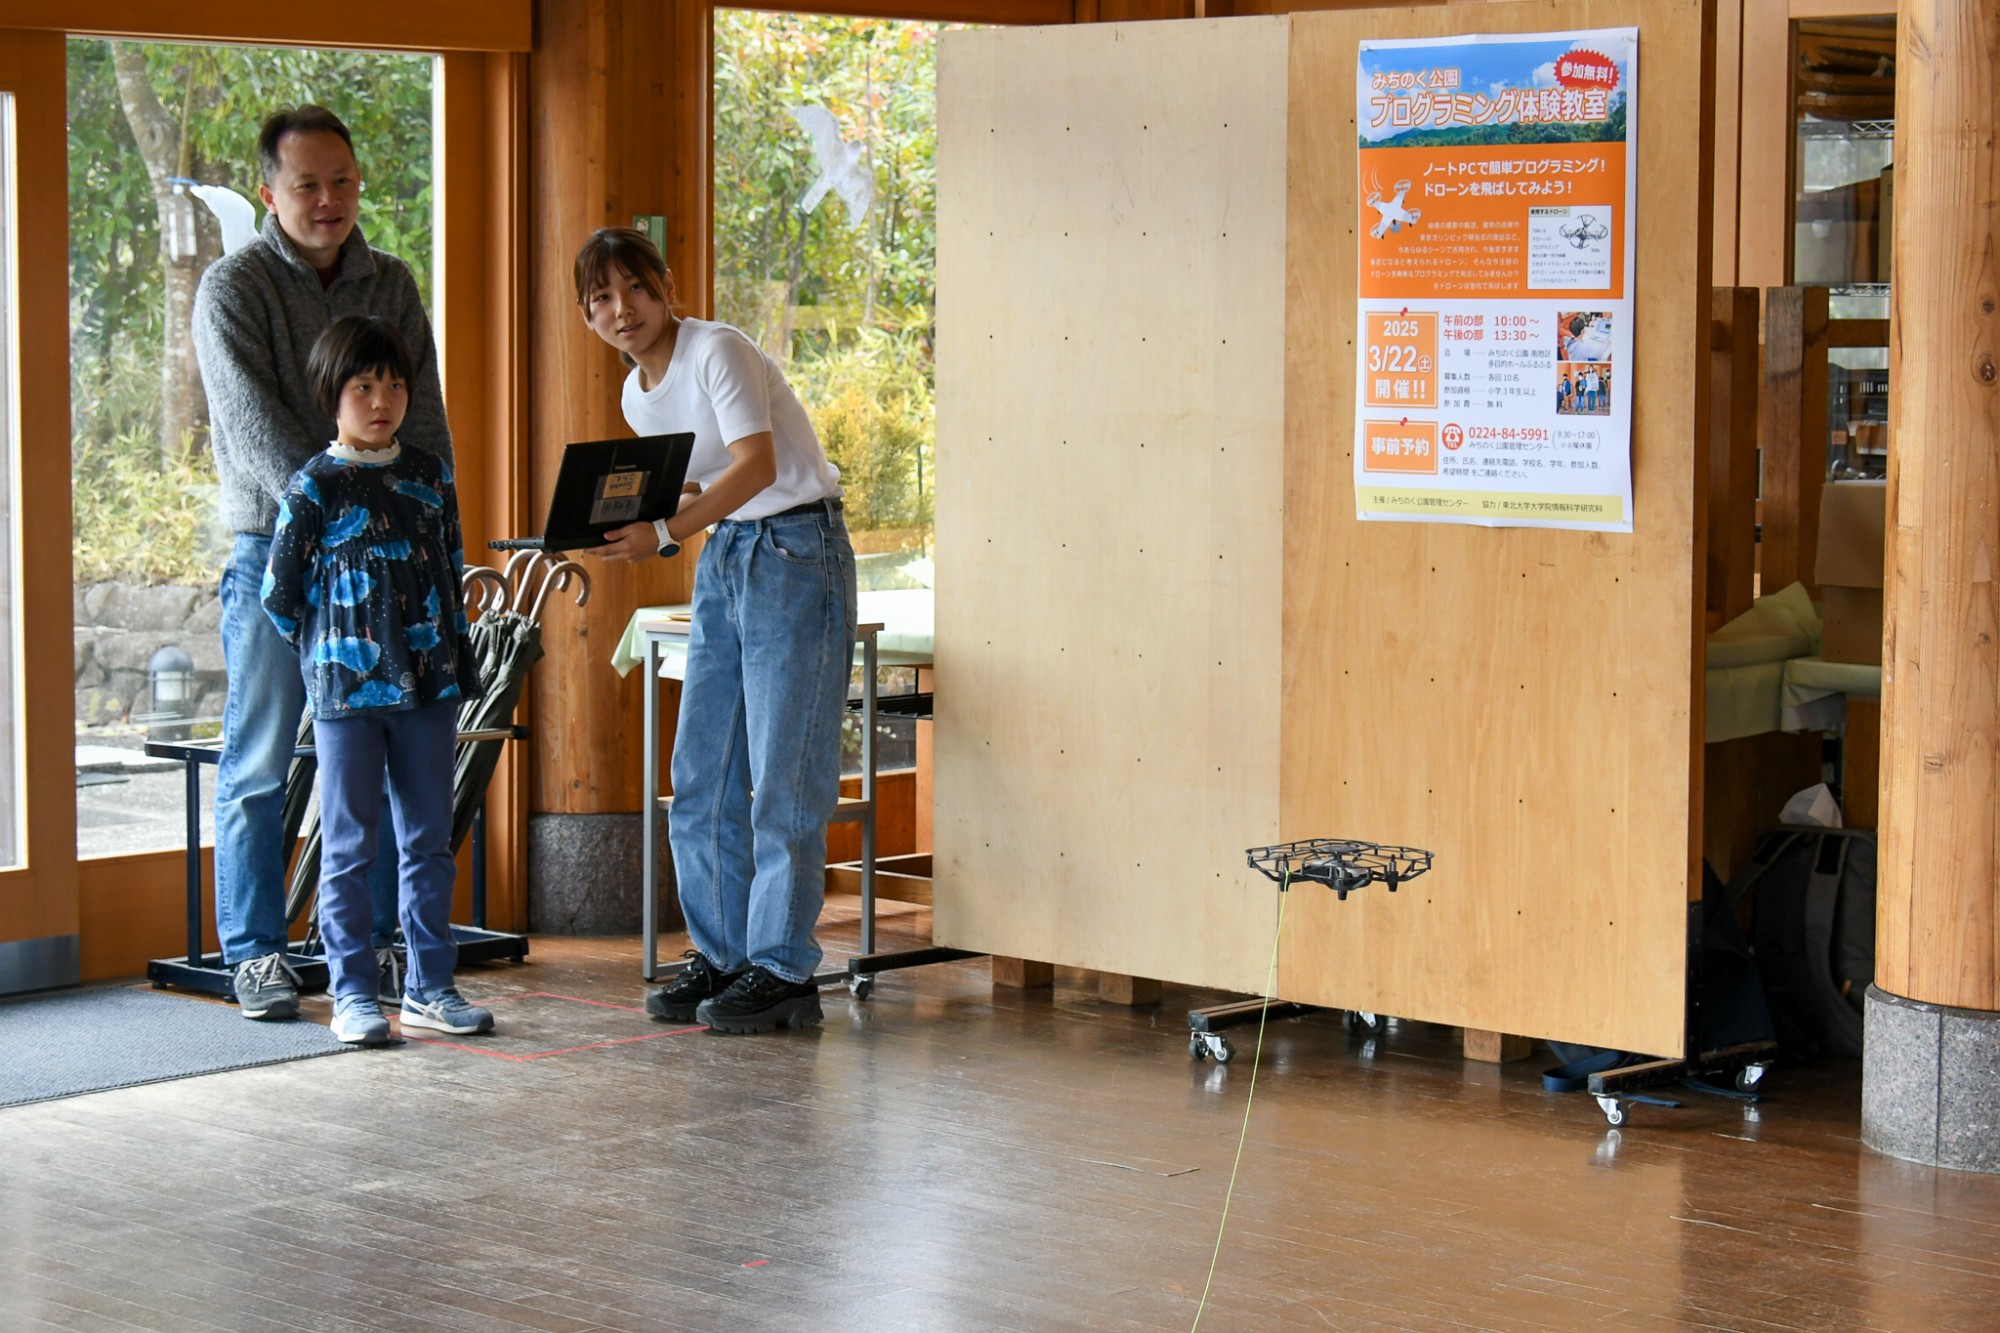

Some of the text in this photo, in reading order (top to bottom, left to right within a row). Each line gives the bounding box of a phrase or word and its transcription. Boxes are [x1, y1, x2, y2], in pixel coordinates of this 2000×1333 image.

[1372, 68, 1459, 90] みちのく公園
[1370, 88, 1607, 127] プログラミング体験教室
[1443, 315, 1484, 327] 午前の部
[1383, 320, 1419, 337] 2025
[1443, 329, 1484, 341] 午後の部
[1368, 345, 1417, 373] 3/22
[1488, 349, 1529, 358] みちのく公園
[1530, 350, 1552, 358] 南地区
[1488, 360, 1552, 368] 多目的ホールふるふる
[1444, 372, 1471, 381] 募集人数
[1444, 386, 1471, 394] 参加資格
[1469, 427, 1548, 441] 0224-84-5991
[1371, 437, 1430, 456] 事前予約
[1469, 442, 1549, 450] みちのく公園管理センター
[1391, 497, 1469, 507] みちのく公園管理センター
[1482, 500, 1496, 509] 協力
[1502, 501, 1603, 513] 東北大学大学院情報科学研究科
